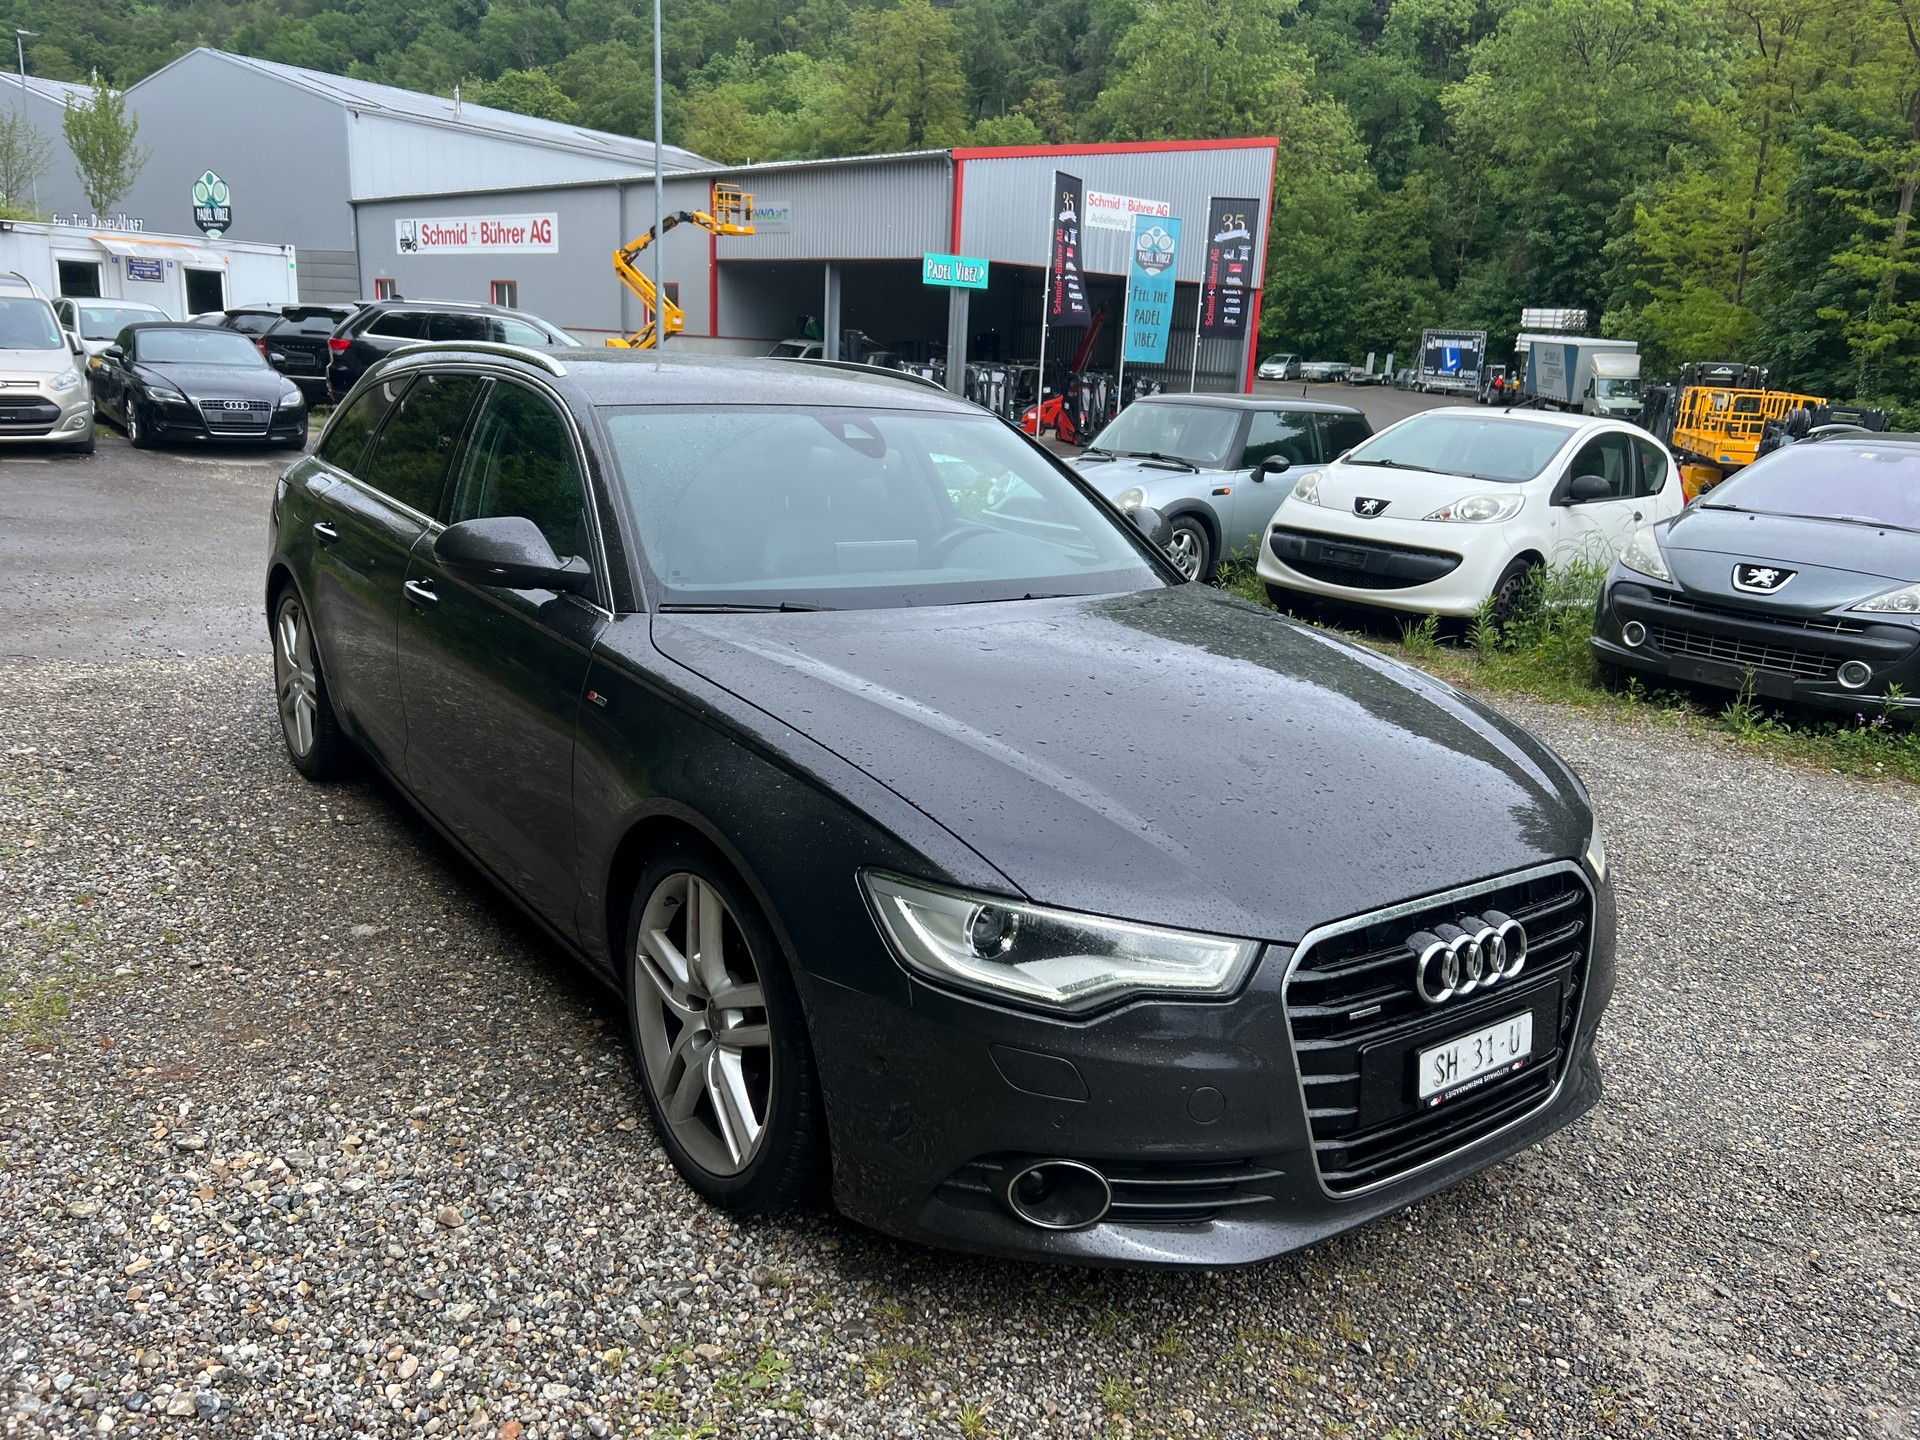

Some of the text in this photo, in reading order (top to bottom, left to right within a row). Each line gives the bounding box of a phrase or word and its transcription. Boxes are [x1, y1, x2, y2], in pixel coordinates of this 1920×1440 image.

[196, 207, 229, 221] PADEL VIBEZ
[1088, 193, 1120, 210] Schmid
[1127, 199, 1154, 214] Bührer
[1155, 204, 1168, 216] AG
[421, 218, 552, 246] Schmid + Bührer AG
[1091, 213, 1128, 228] Anlieferung
[1221, 213, 1246, 234] 35
[1056, 228, 1064, 242] AG
[1054, 245, 1064, 275] Bührer
[1210, 248, 1220, 262] AG
[927, 258, 979, 283] PADEL VIBEZ
[1207, 263, 1219, 290] Bührer
[1053, 280, 1063, 315] Schmid
[1133, 285, 1168, 304] FEEL THE
[1133, 308, 1161, 326] PADEL
[1205, 295, 1216, 326] Schmid
[1133, 331, 1158, 348] VIBEZ
[1433, 1021, 1522, 1088] SH 31 U
[1444, 1067, 1510, 1100] AUTOHAUS RHEINPARADIES
